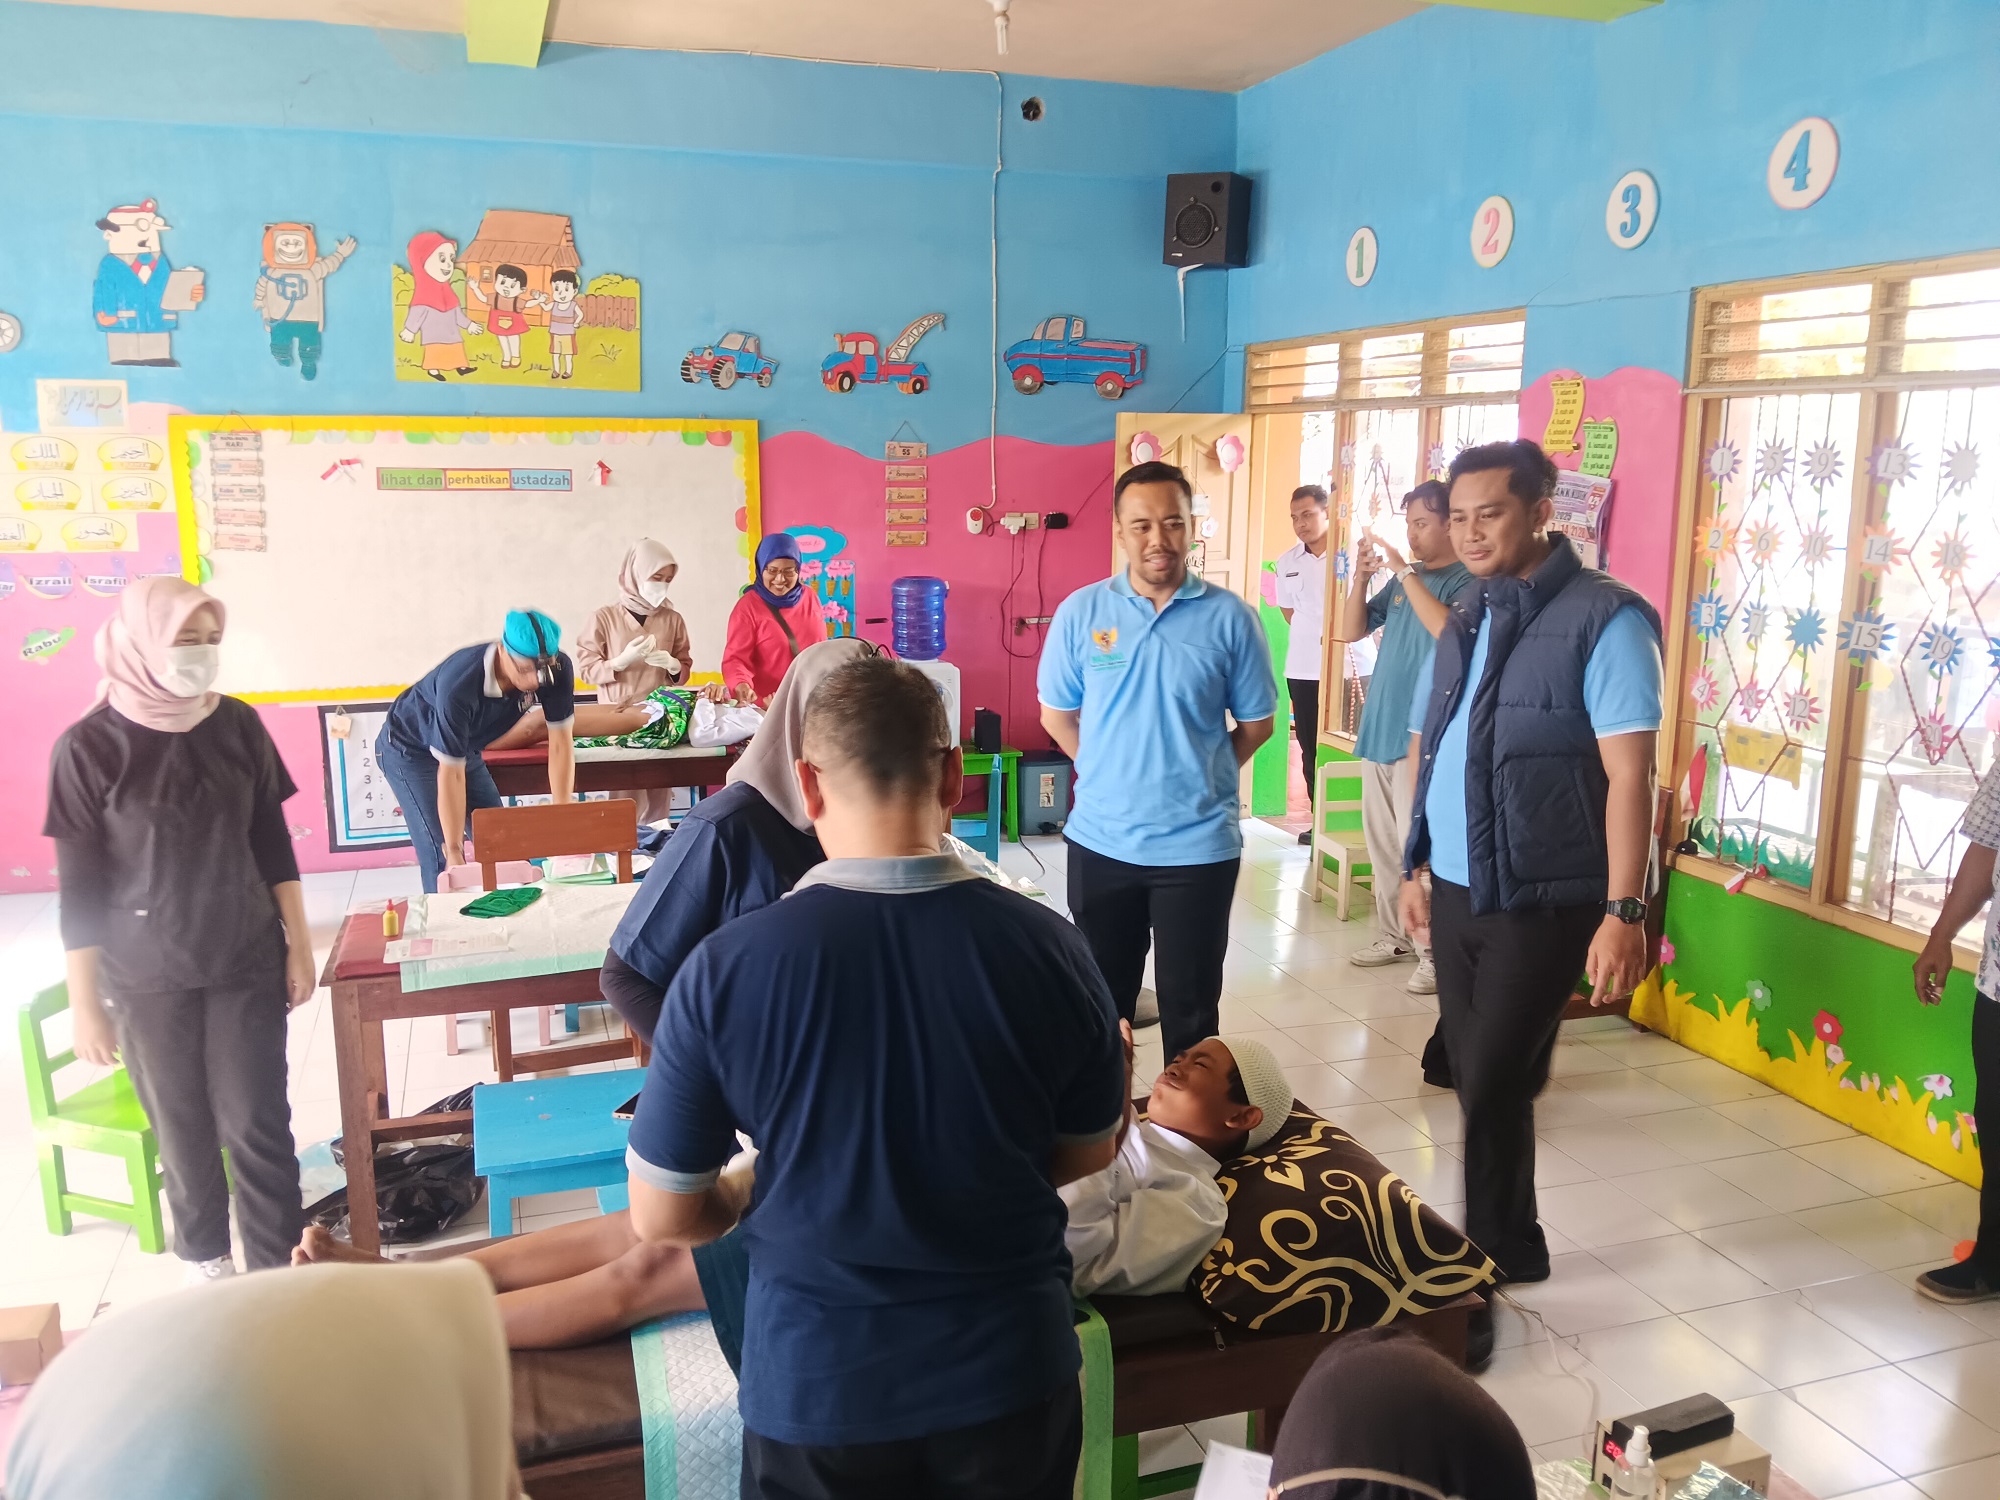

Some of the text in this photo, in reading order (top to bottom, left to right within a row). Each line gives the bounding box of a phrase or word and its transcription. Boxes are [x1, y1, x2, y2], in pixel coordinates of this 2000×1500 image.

[1782, 129, 1812, 192] 4
[1618, 183, 1643, 239] 3
[1480, 206, 1501, 255] 2
[1354, 236, 1365, 279] 1
[1718, 451, 1726, 471] 1
[1766, 451, 1779, 471] 5
[1817, 452, 1830, 473] 9
[1882, 451, 1908, 475] 13
[381, 473, 570, 488] lihat dan perhatikan ustadzah
[1708, 529, 1721, 549] 2
[1757, 530, 1772, 551] 6
[1865, 538, 1890, 562] 14
[1703, 605, 1713, 625] 3
[23, 635, 63, 657] Rabu
[1853, 625, 1880, 648] 15
[1931, 635, 1952, 660] 19
[1790, 696, 1808, 718] 12
[363, 757, 371, 768] 2
[364, 775, 372, 785] 3
[365, 792, 373, 802] 4
[366, 809, 374, 819] 5
